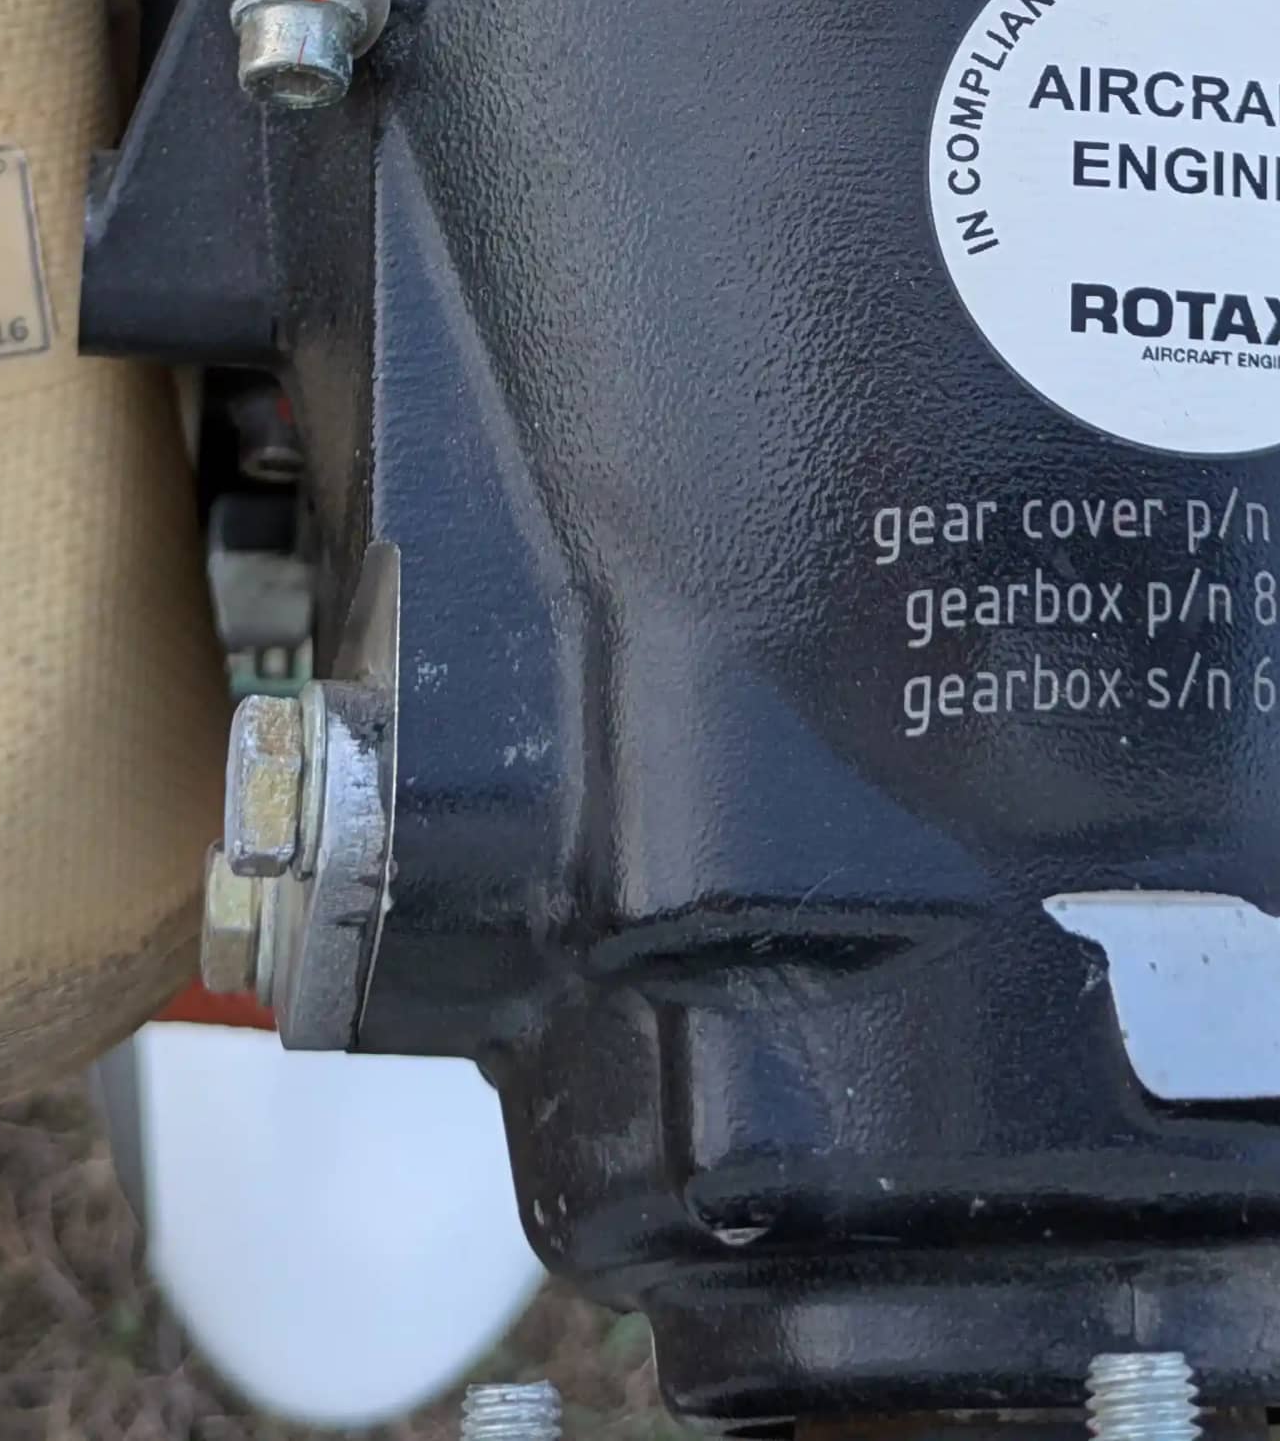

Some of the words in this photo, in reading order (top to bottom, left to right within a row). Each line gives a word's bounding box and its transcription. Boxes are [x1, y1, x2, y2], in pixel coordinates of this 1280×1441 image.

[956, 209, 1000, 255] IN
[1141, 345, 1233, 367] AIRCRAFT
[872, 501, 997, 565] gear
[1022, 497, 1164, 539] cover
[1185, 487, 1271, 554] p/n
[905, 568, 1123, 647] gearbox
[1146, 568, 1233, 638] p/n
[903, 654, 1122, 737] gearbox
[1145, 653, 1233, 710] s/n
